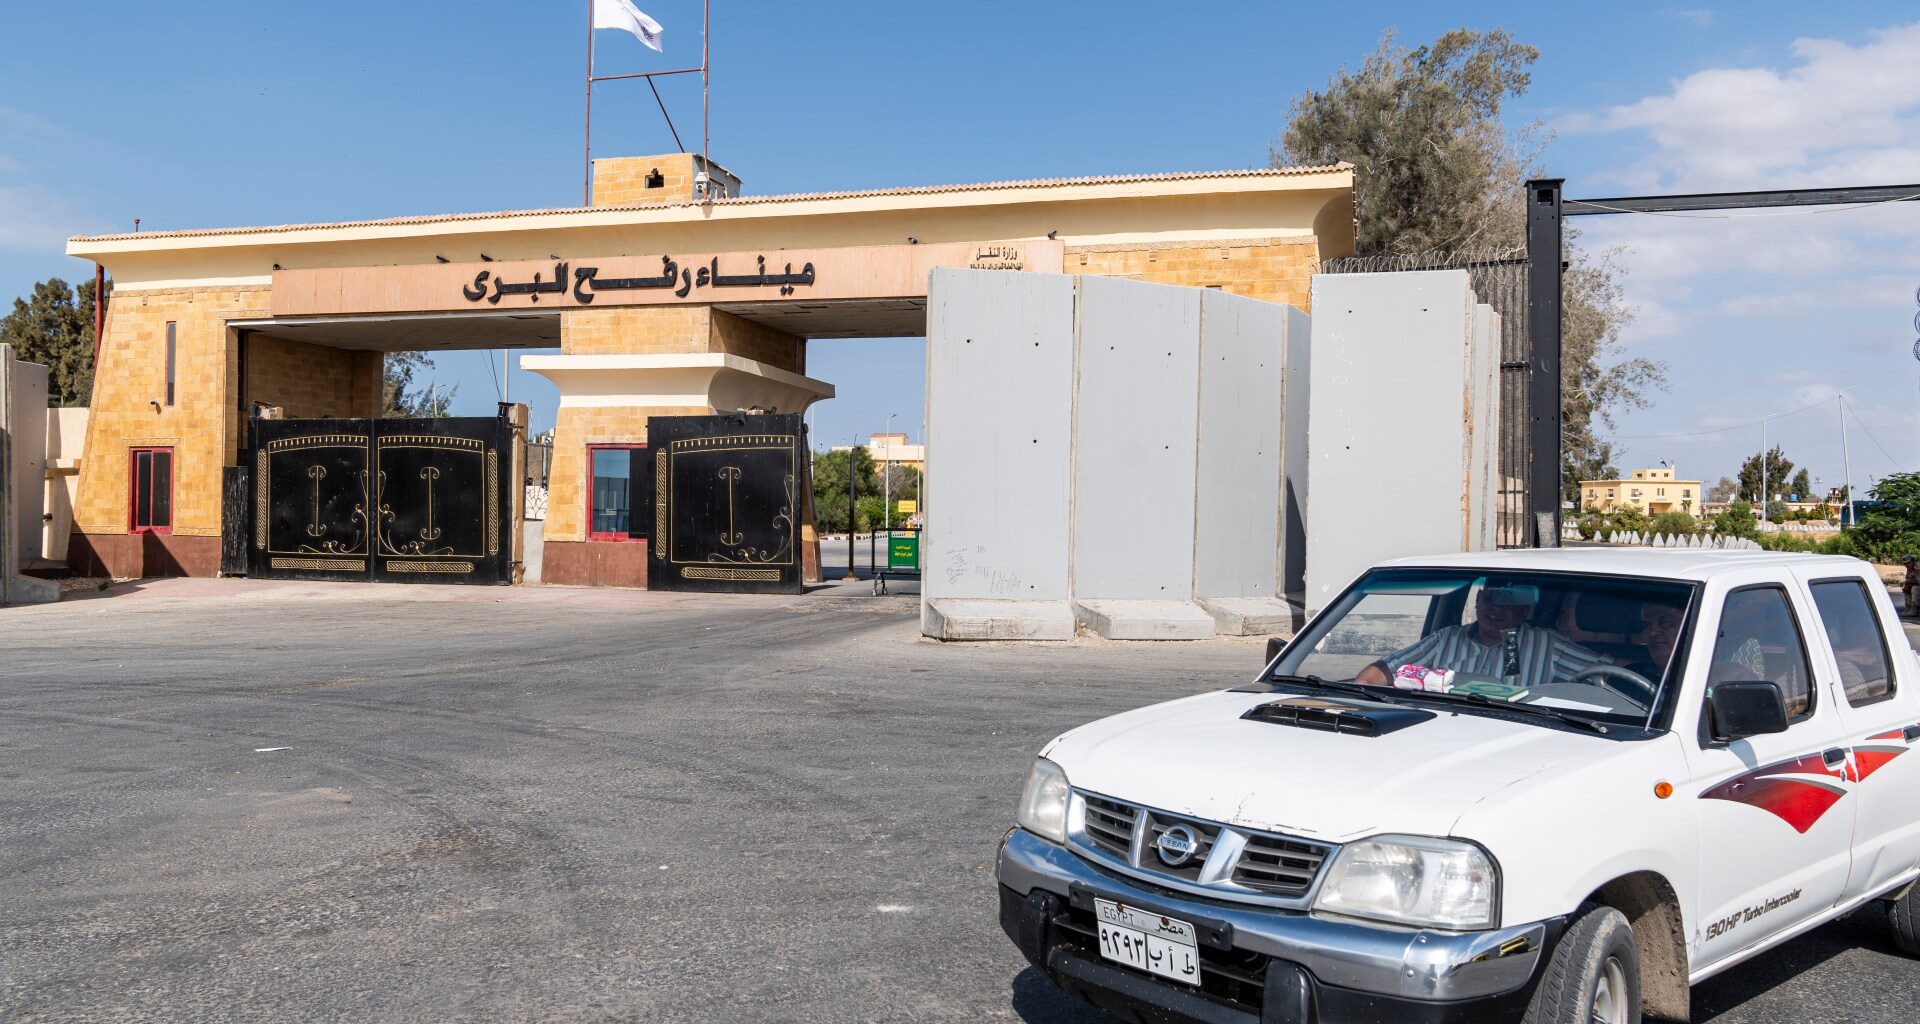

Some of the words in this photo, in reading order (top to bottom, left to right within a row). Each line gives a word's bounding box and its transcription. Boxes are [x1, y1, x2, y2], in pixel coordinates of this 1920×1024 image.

[976, 246, 1000, 261] النقل
[573, 254, 691, 304] رفح
[695, 254, 815, 296] ميناء
[1103, 906, 1135, 926] EGYPT
[1743, 905, 1764, 923] Turbo
[1763, 888, 1802, 914] Intercooler
[1101, 928, 1144, 964] ٩٢٩٣
